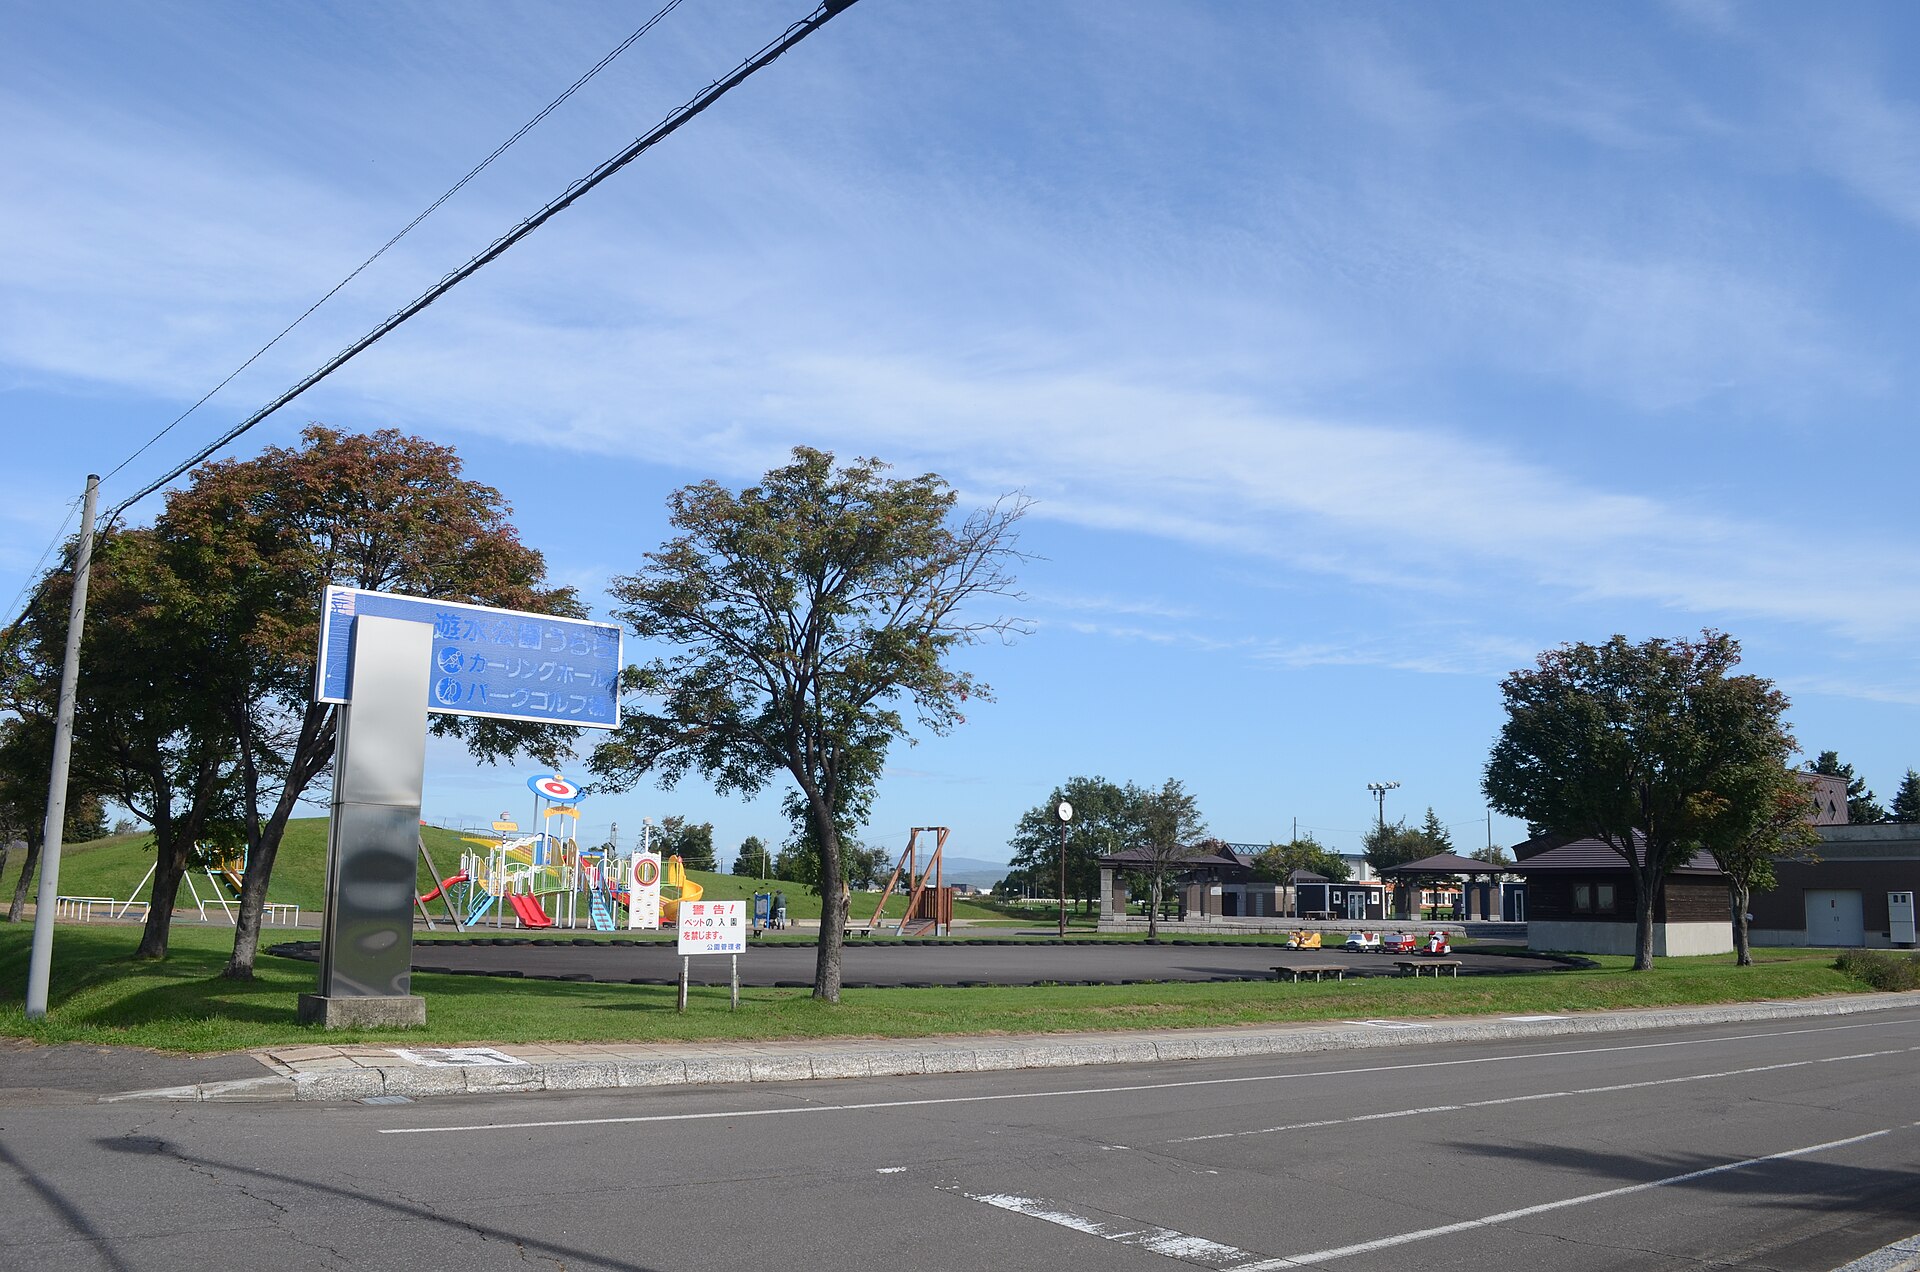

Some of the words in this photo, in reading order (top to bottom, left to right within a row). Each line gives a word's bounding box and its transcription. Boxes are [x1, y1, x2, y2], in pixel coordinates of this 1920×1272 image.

[683, 931, 722, 940] を禁じます。
